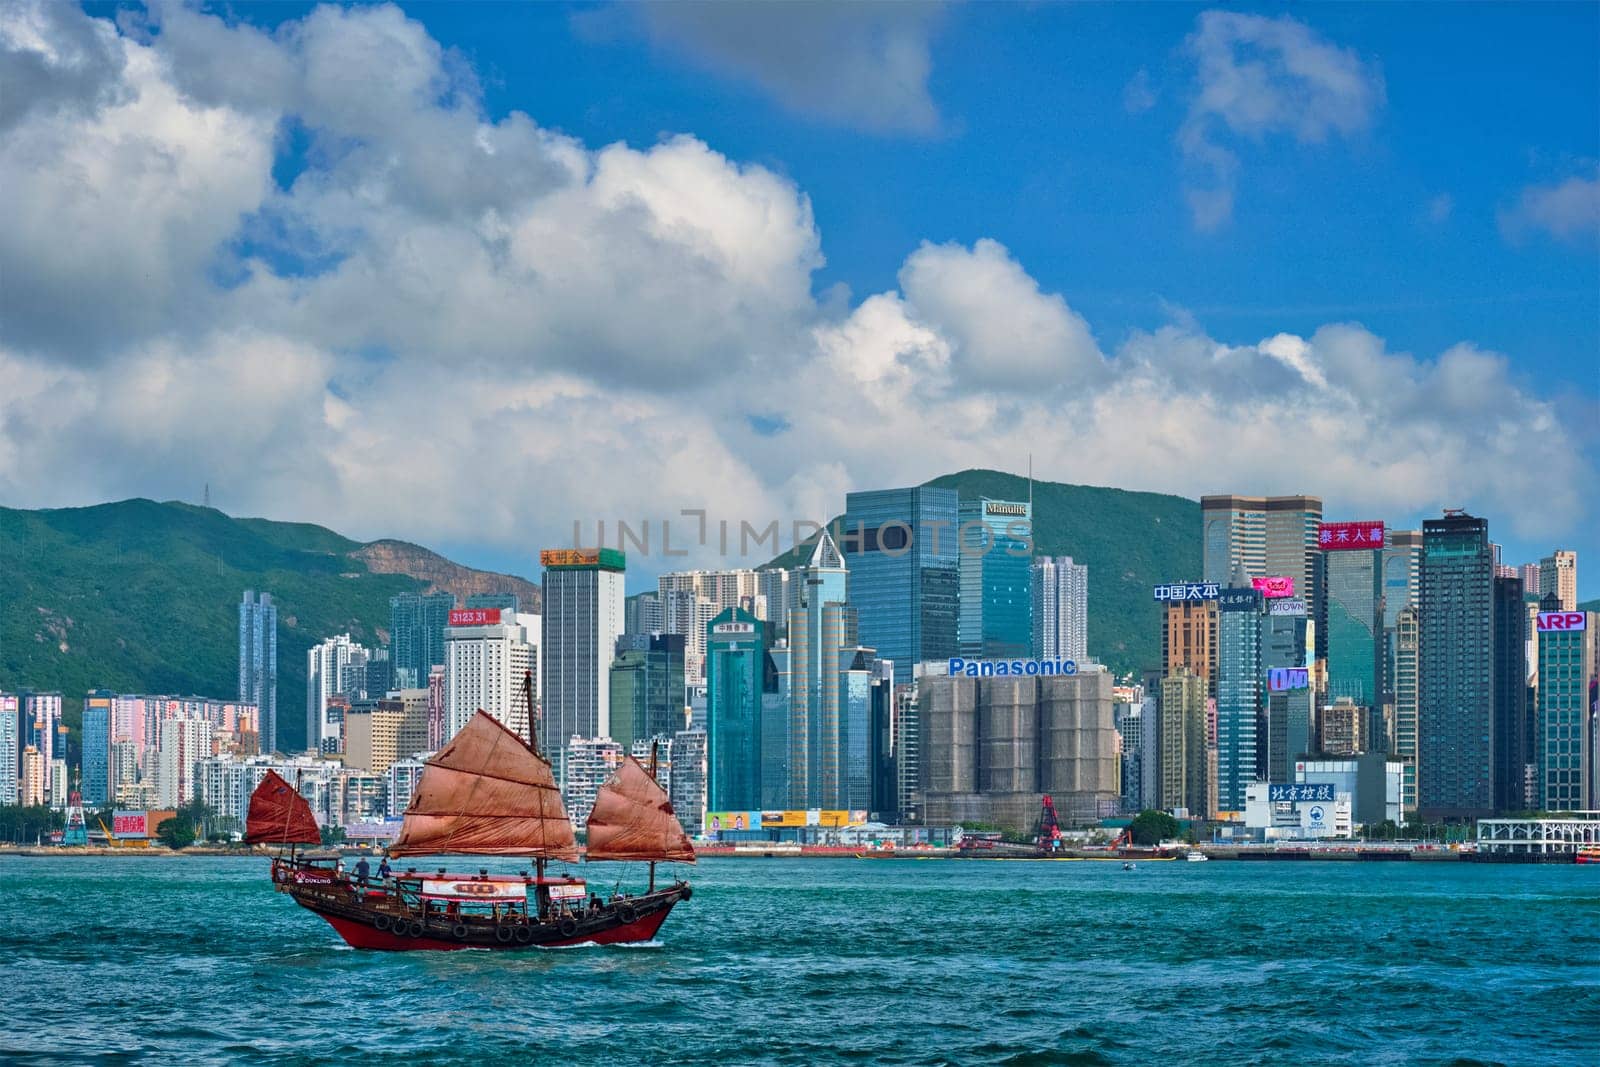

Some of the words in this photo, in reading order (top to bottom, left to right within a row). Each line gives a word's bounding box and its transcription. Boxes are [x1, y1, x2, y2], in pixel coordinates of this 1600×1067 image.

[987, 503, 1026, 515] Manulife
[1154, 584, 1219, 601] 中国太平
[949, 655, 1077, 677] Panasonic
[1271, 785, 1332, 800] 北京控股
